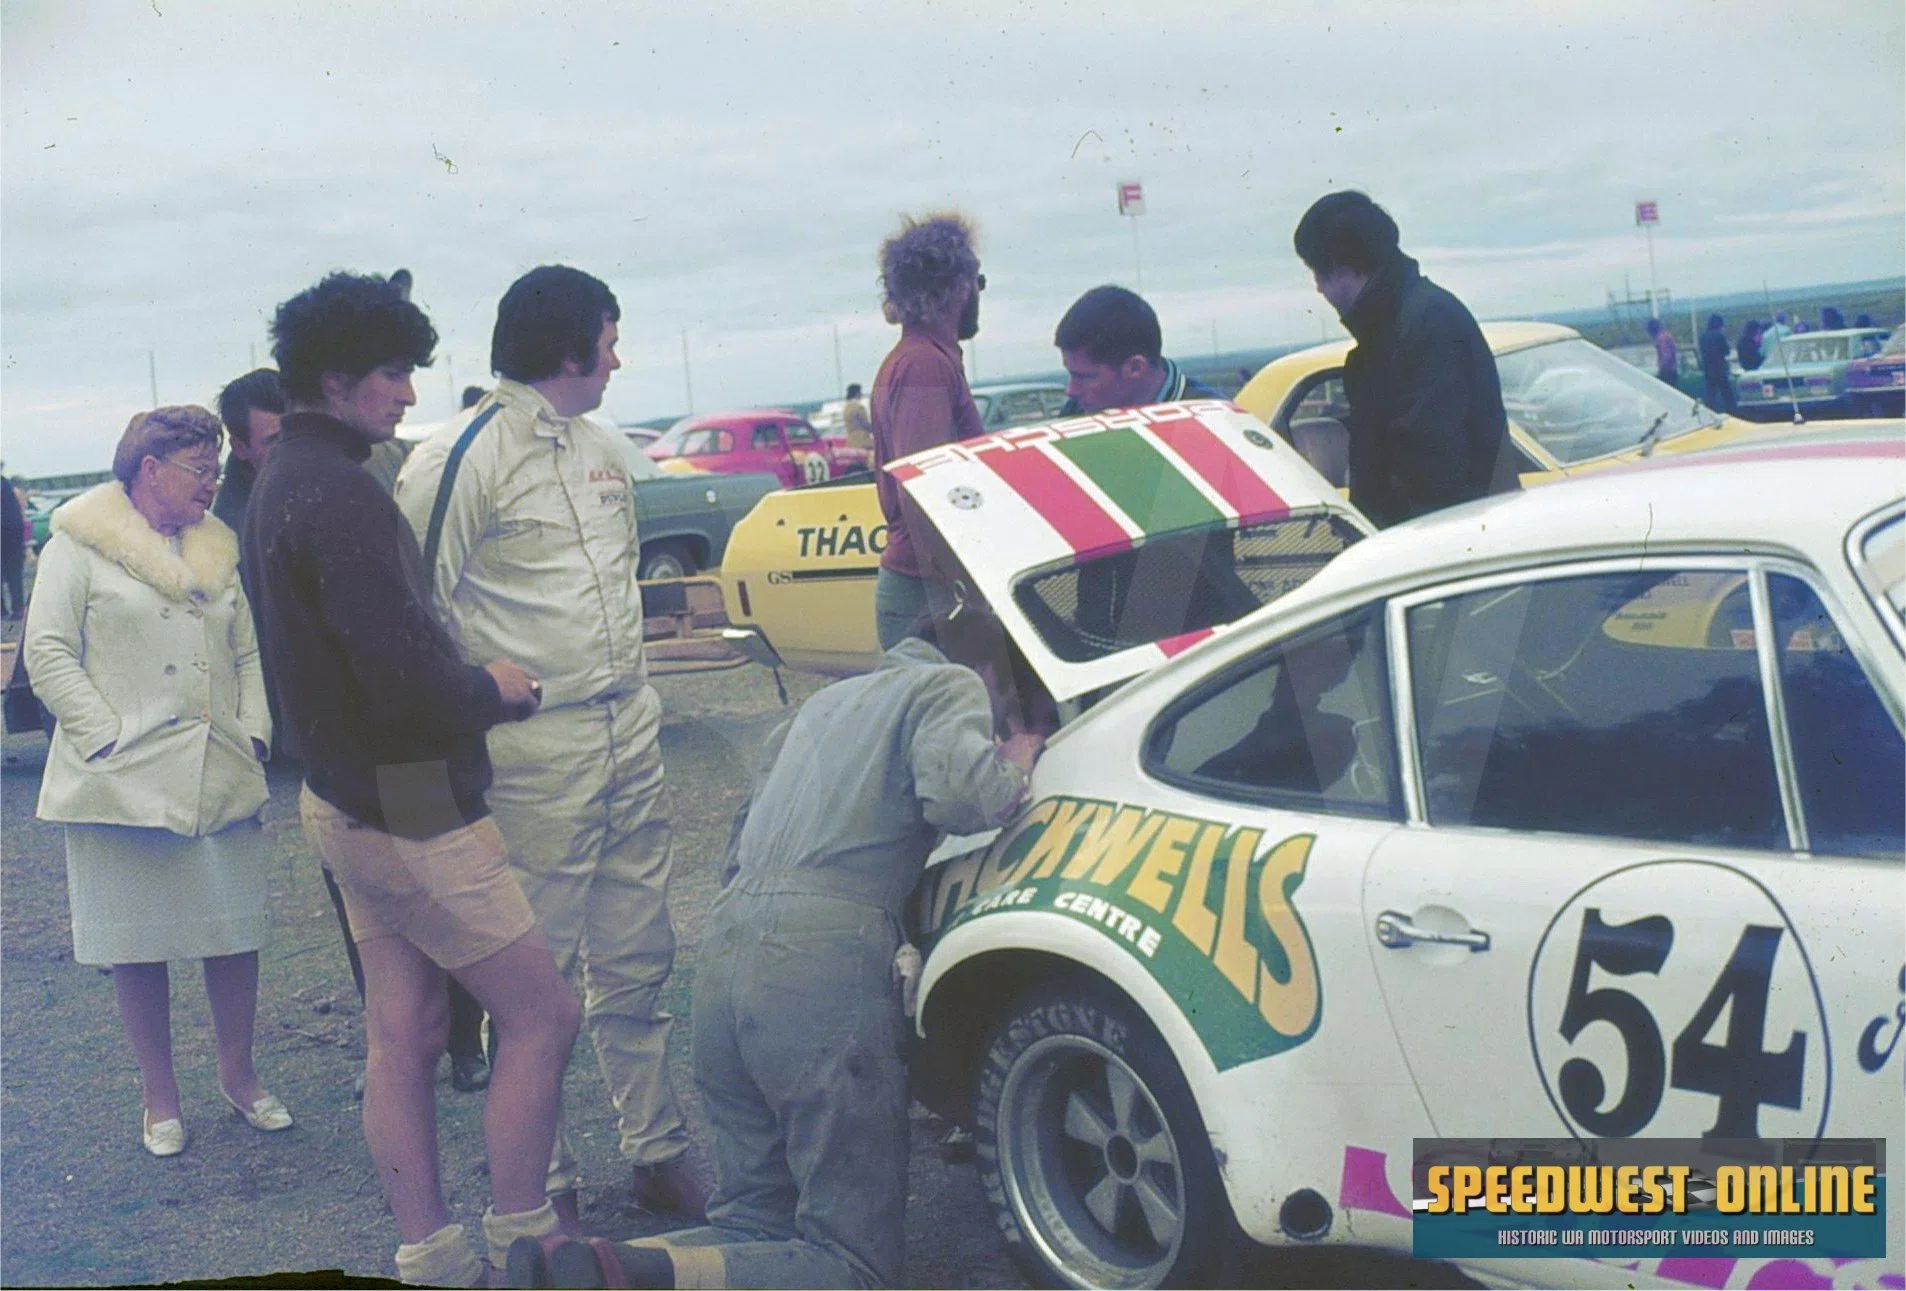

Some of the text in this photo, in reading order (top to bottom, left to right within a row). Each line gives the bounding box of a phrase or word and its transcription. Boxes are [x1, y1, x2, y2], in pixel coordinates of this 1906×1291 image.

[908, 400, 1236, 470] PORSCHE
[767, 571, 792, 585] GS
[1054, 891, 1162, 958] CENTRE
[1558, 907, 1807, 1163] 54
